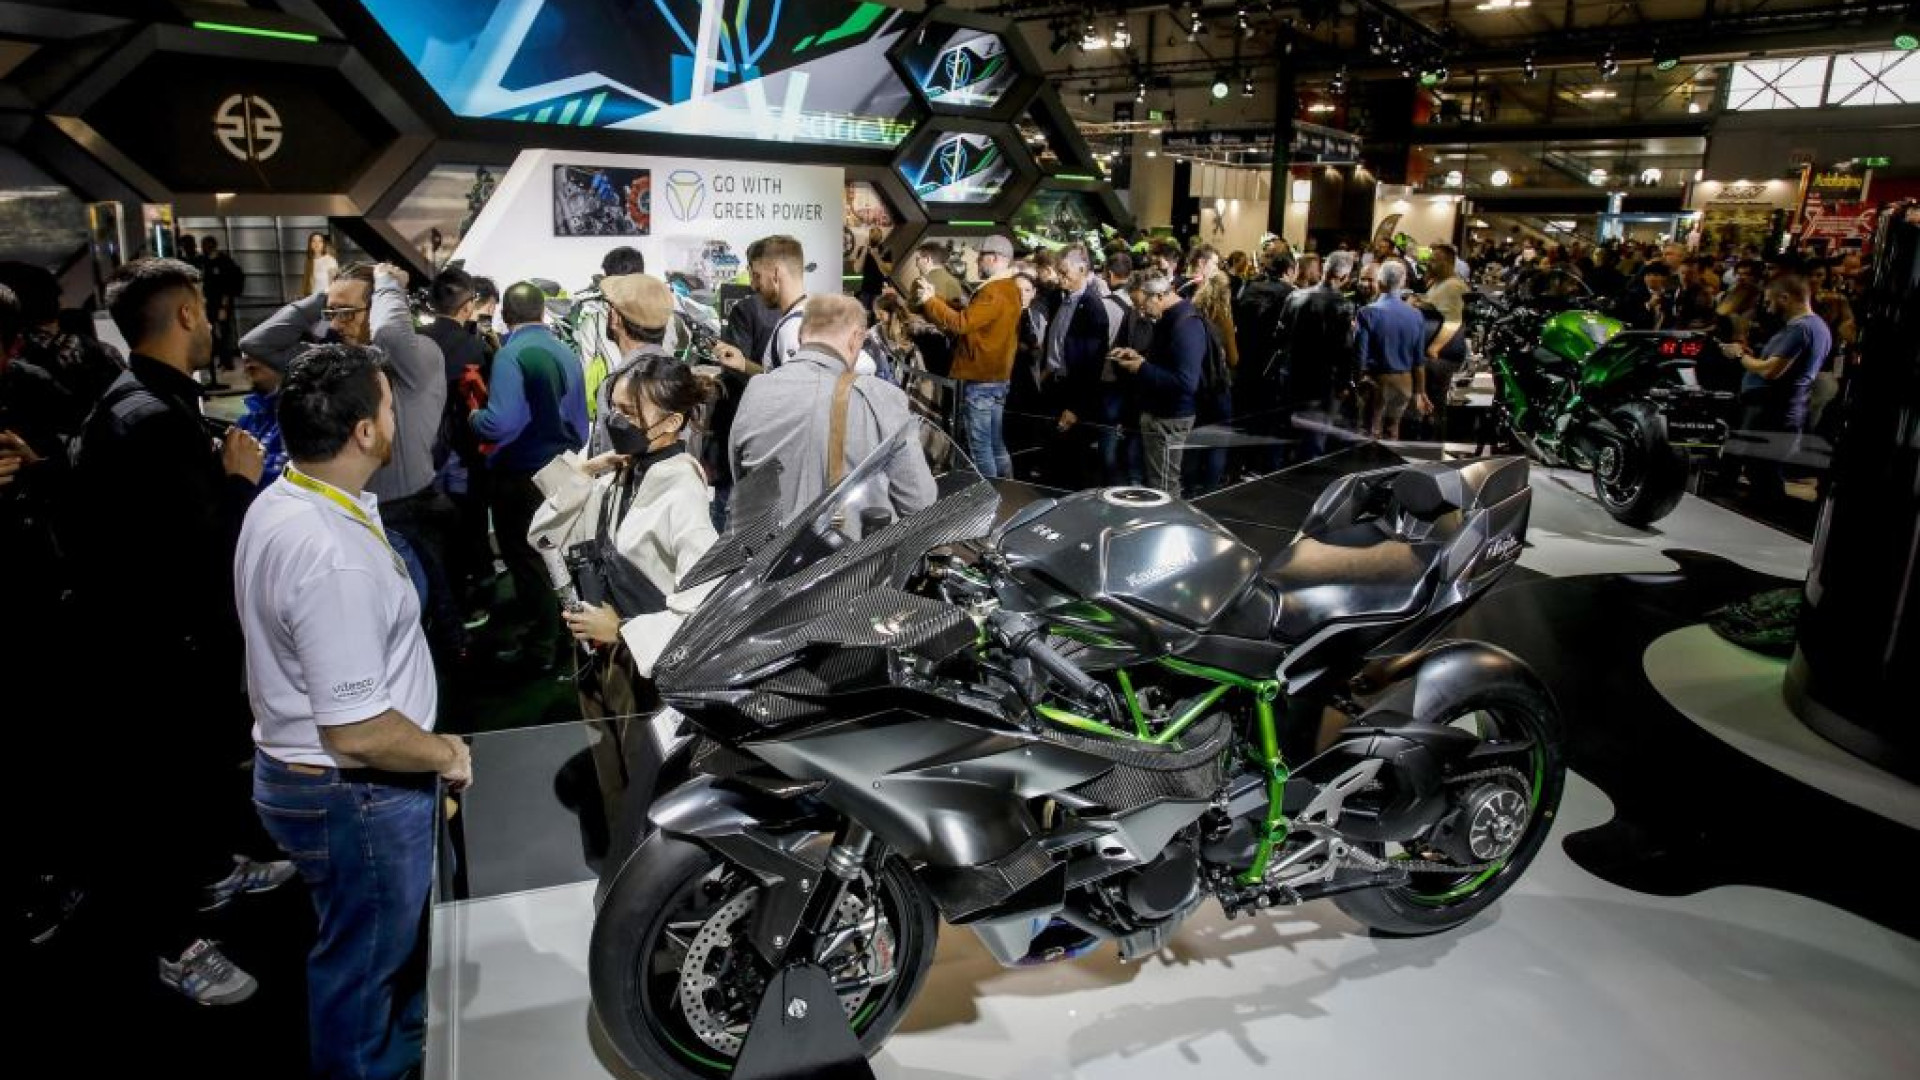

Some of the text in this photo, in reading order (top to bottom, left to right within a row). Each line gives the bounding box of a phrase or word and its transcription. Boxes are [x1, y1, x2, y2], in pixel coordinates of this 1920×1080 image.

[712, 175, 782, 195] GO WITH
[712, 202, 823, 221] GREEN POWER
